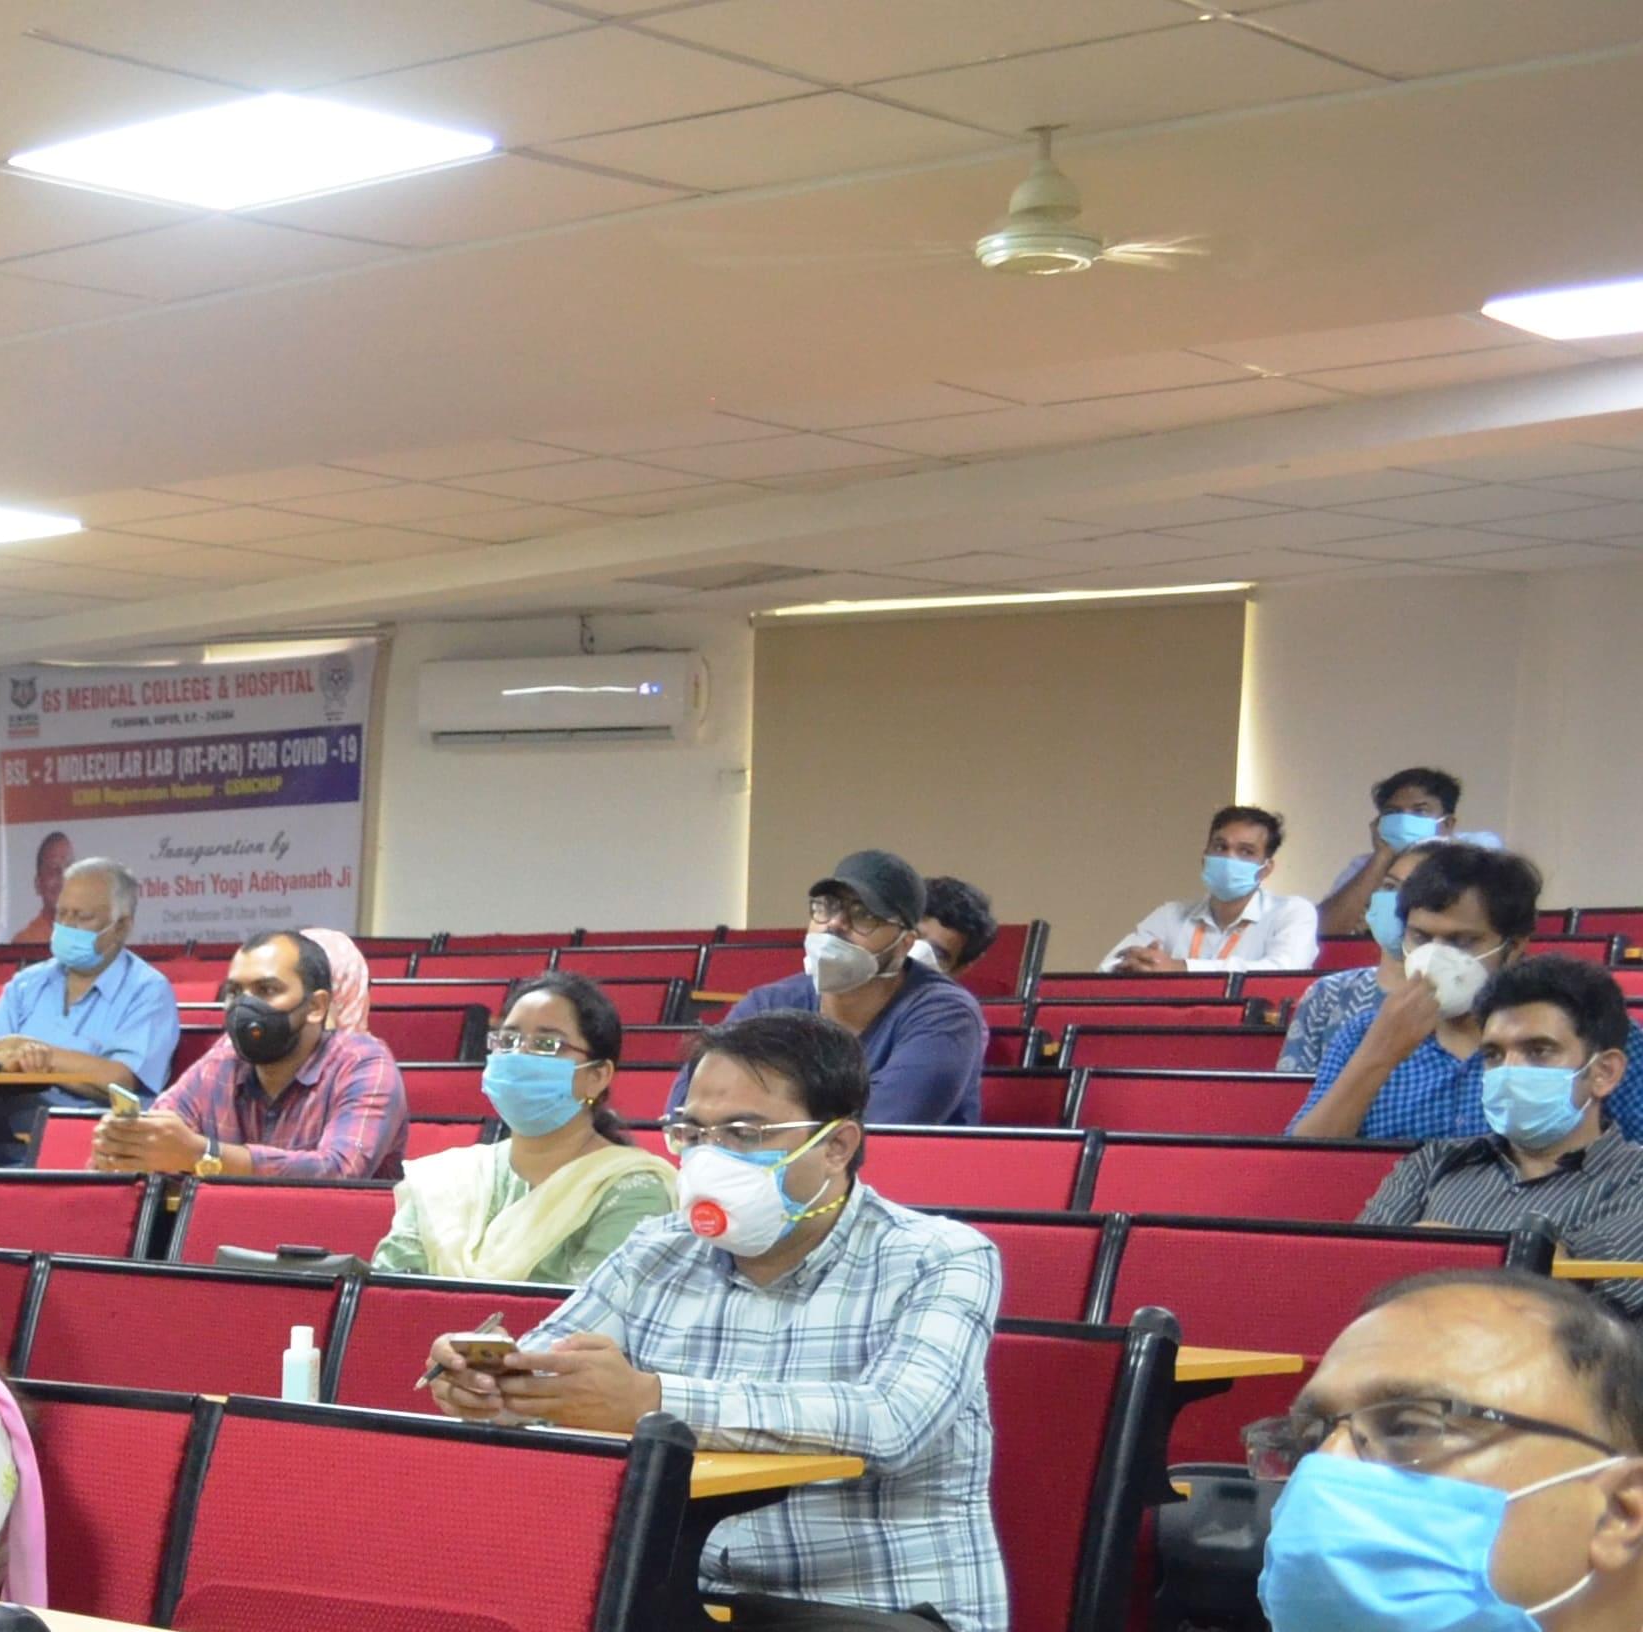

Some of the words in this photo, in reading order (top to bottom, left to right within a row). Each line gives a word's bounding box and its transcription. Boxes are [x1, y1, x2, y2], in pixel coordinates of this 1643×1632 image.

[42, 688, 62, 713] GS
[66, 682, 137, 711] MEDICAL
[142, 677, 214, 706] COLLEGE
[218, 676, 229, 698] &
[234, 669, 315, 697] HOSPITAL
[43, 756, 54, 784] 2
[57, 750, 143, 784] MOLECULAR
[146, 748, 174, 778] LAB
[178, 743, 244, 779] (RT-PCR)
[248, 739, 278, 770] FOR
[281, 736, 328, 767] COVID
[331, 735, 358, 763] -19
[149, 836, 265, 865] Inauguration
[269, 830, 290, 861] by
[174, 872, 205, 897] Shri
[210, 871, 243, 900] Yogi
[249, 866, 332, 897] Adityanath
[337, 866, 353, 888] Ji
